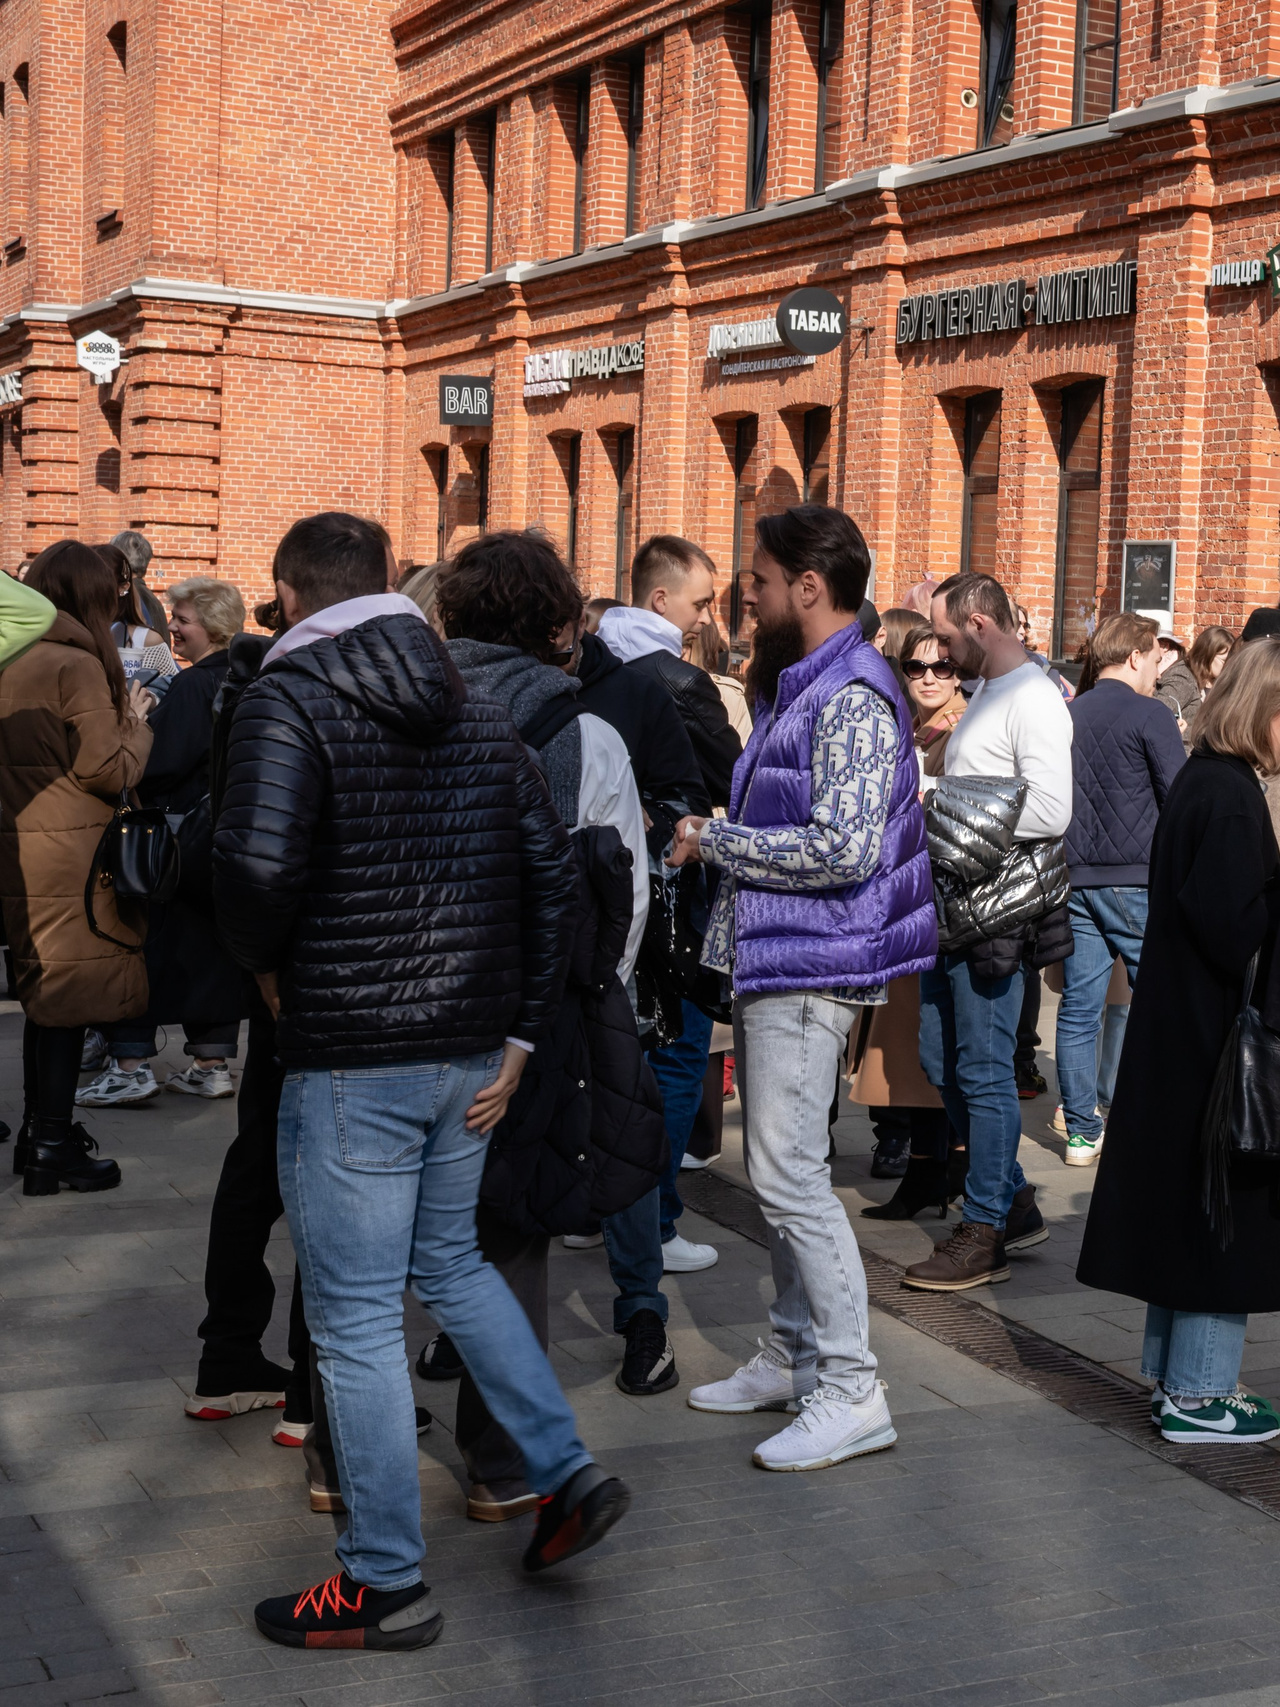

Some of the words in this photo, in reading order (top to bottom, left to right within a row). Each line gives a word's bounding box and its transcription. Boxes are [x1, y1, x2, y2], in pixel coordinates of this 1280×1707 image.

[1211, 259, 1263, 287] ПИЦЦА
[896, 279, 1024, 345] БУРГЕРНАЯ
[1035, 260, 1138, 326] МИТИНГ
[788, 308, 842, 334] ТАБАК
[570, 346, 618, 380] ПРАВДА
[616, 340, 645, 367] КОФЕ
[721, 359, 765, 376] КОНДИТЕРСКАЯ
[445, 386, 488, 415] BAR
